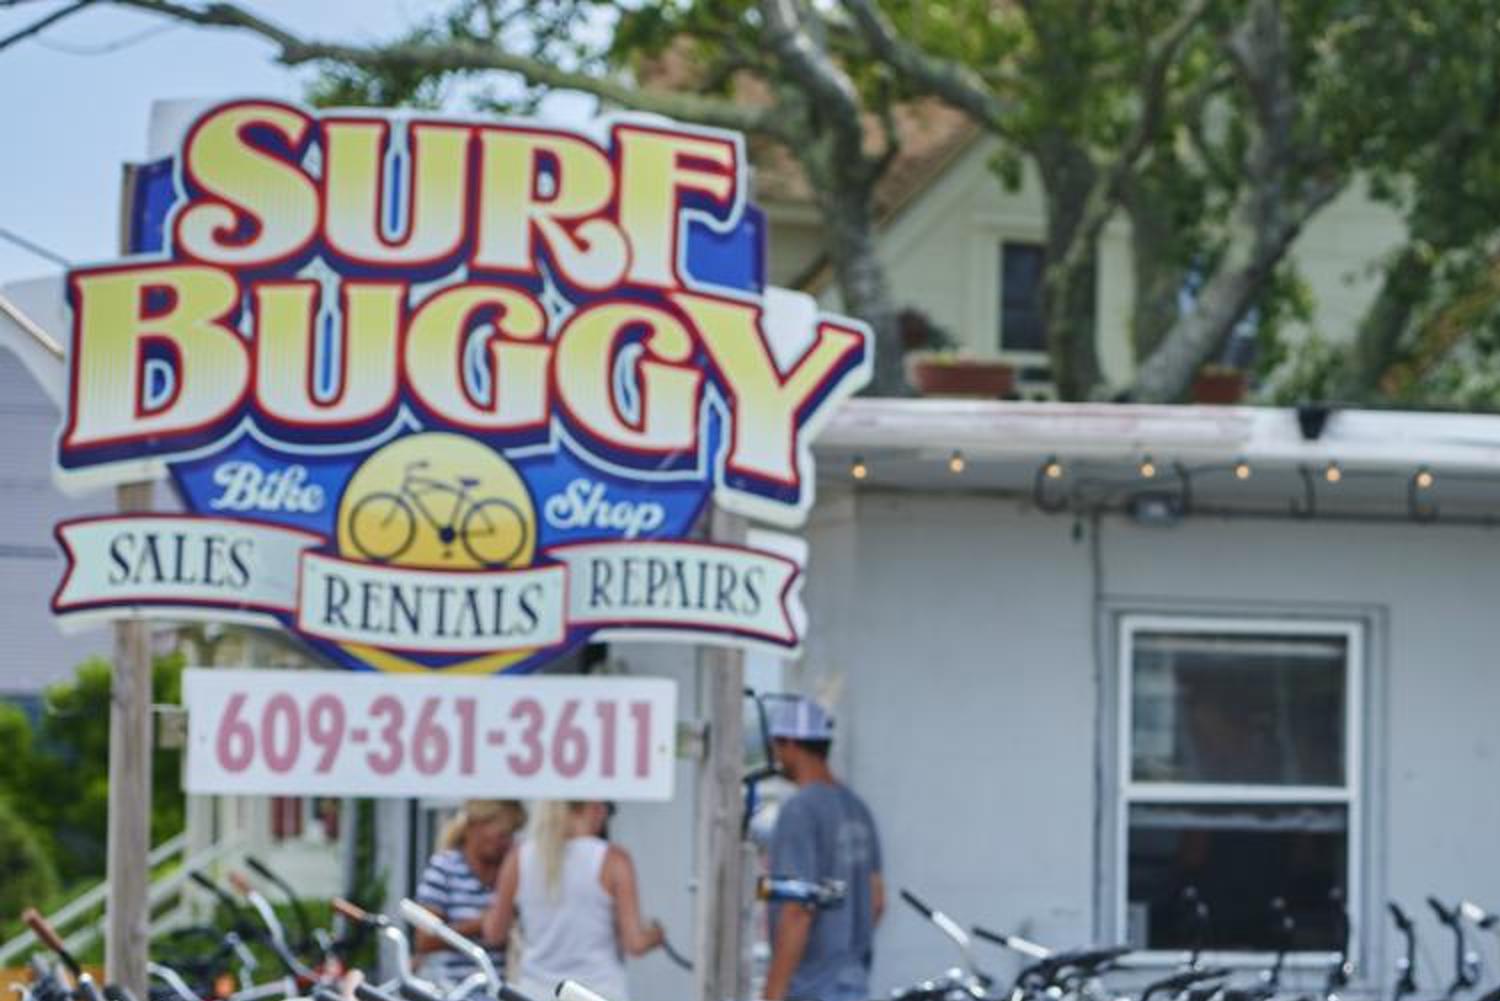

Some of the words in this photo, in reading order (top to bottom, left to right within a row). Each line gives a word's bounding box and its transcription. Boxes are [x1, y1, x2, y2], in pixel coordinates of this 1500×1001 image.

[173, 97, 739, 292] SURF
[61, 263, 866, 485] BUGGY
[210, 461, 325, 513] Bike
[544, 478, 664, 540] Shop
[108, 530, 254, 588] SALES
[589, 557, 768, 617] REPAIRS
[322, 573, 543, 640] RENTALS
[214, 692, 653, 779] 609-361-3611
